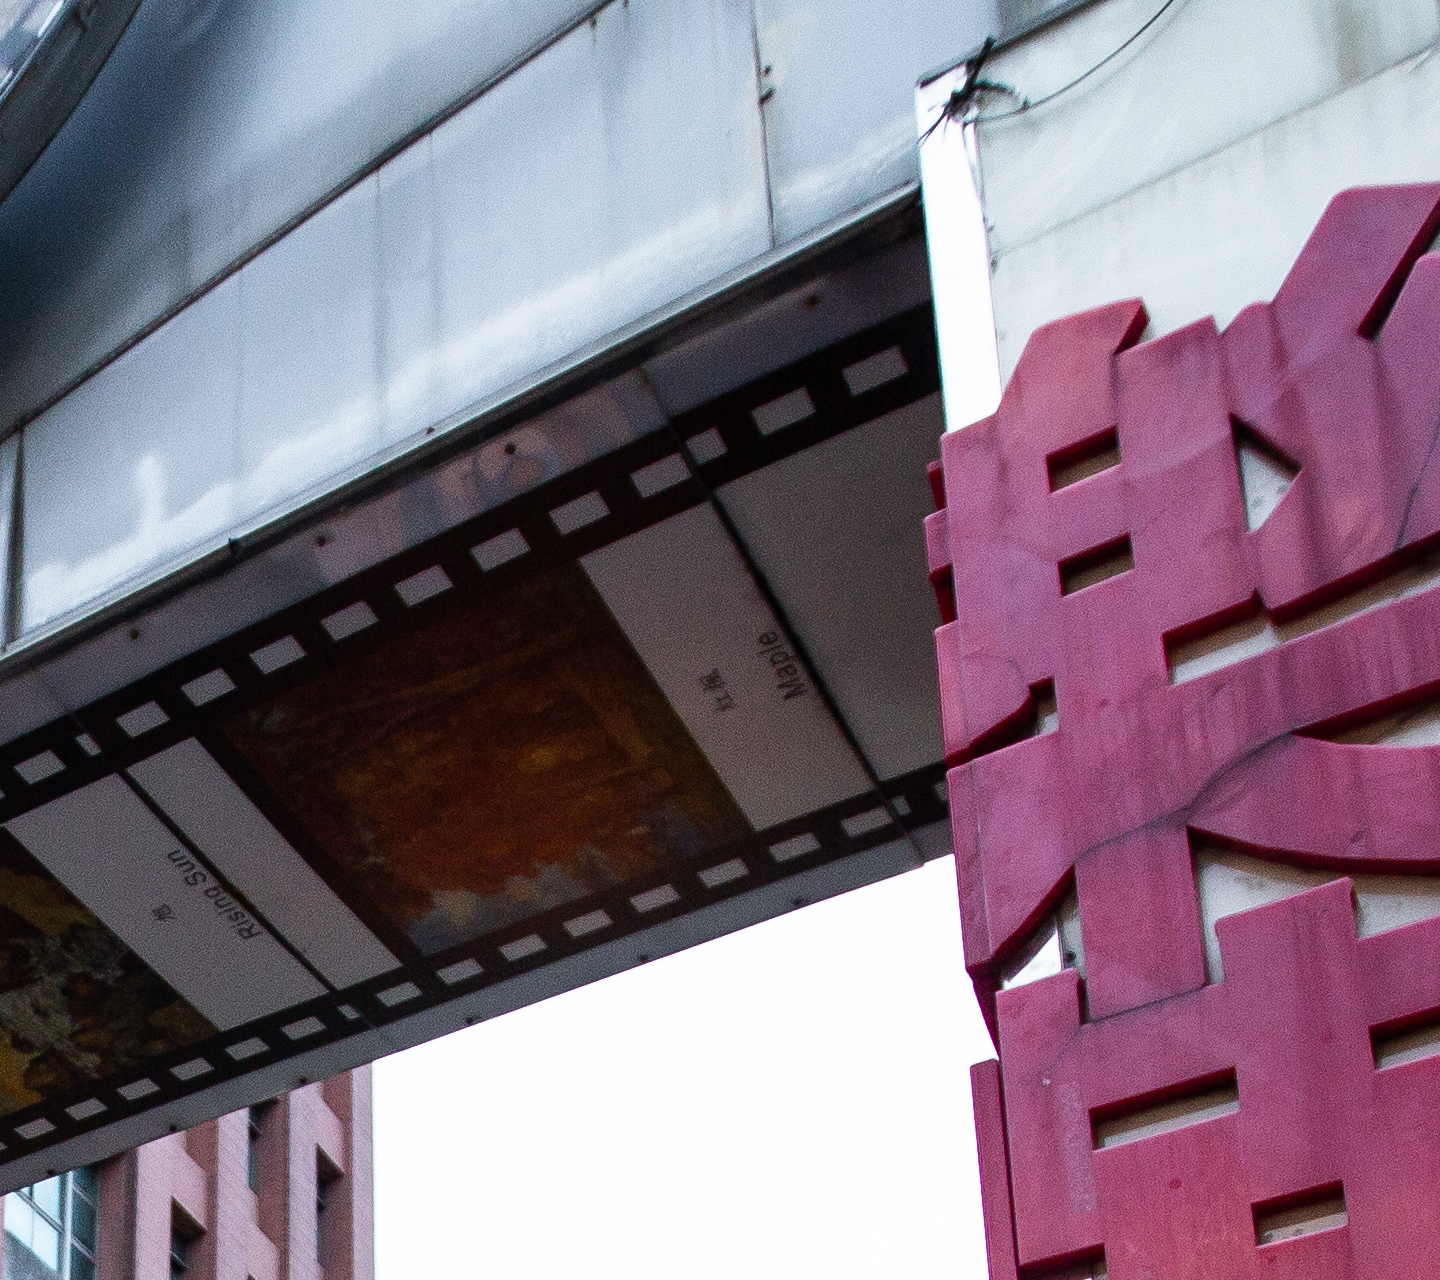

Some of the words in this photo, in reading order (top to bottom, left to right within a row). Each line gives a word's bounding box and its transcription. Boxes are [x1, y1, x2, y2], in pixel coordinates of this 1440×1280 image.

[757, 632, 809, 700] Maple
[167, 849, 208, 886] Sun
[203, 885, 262, 940] Rising
